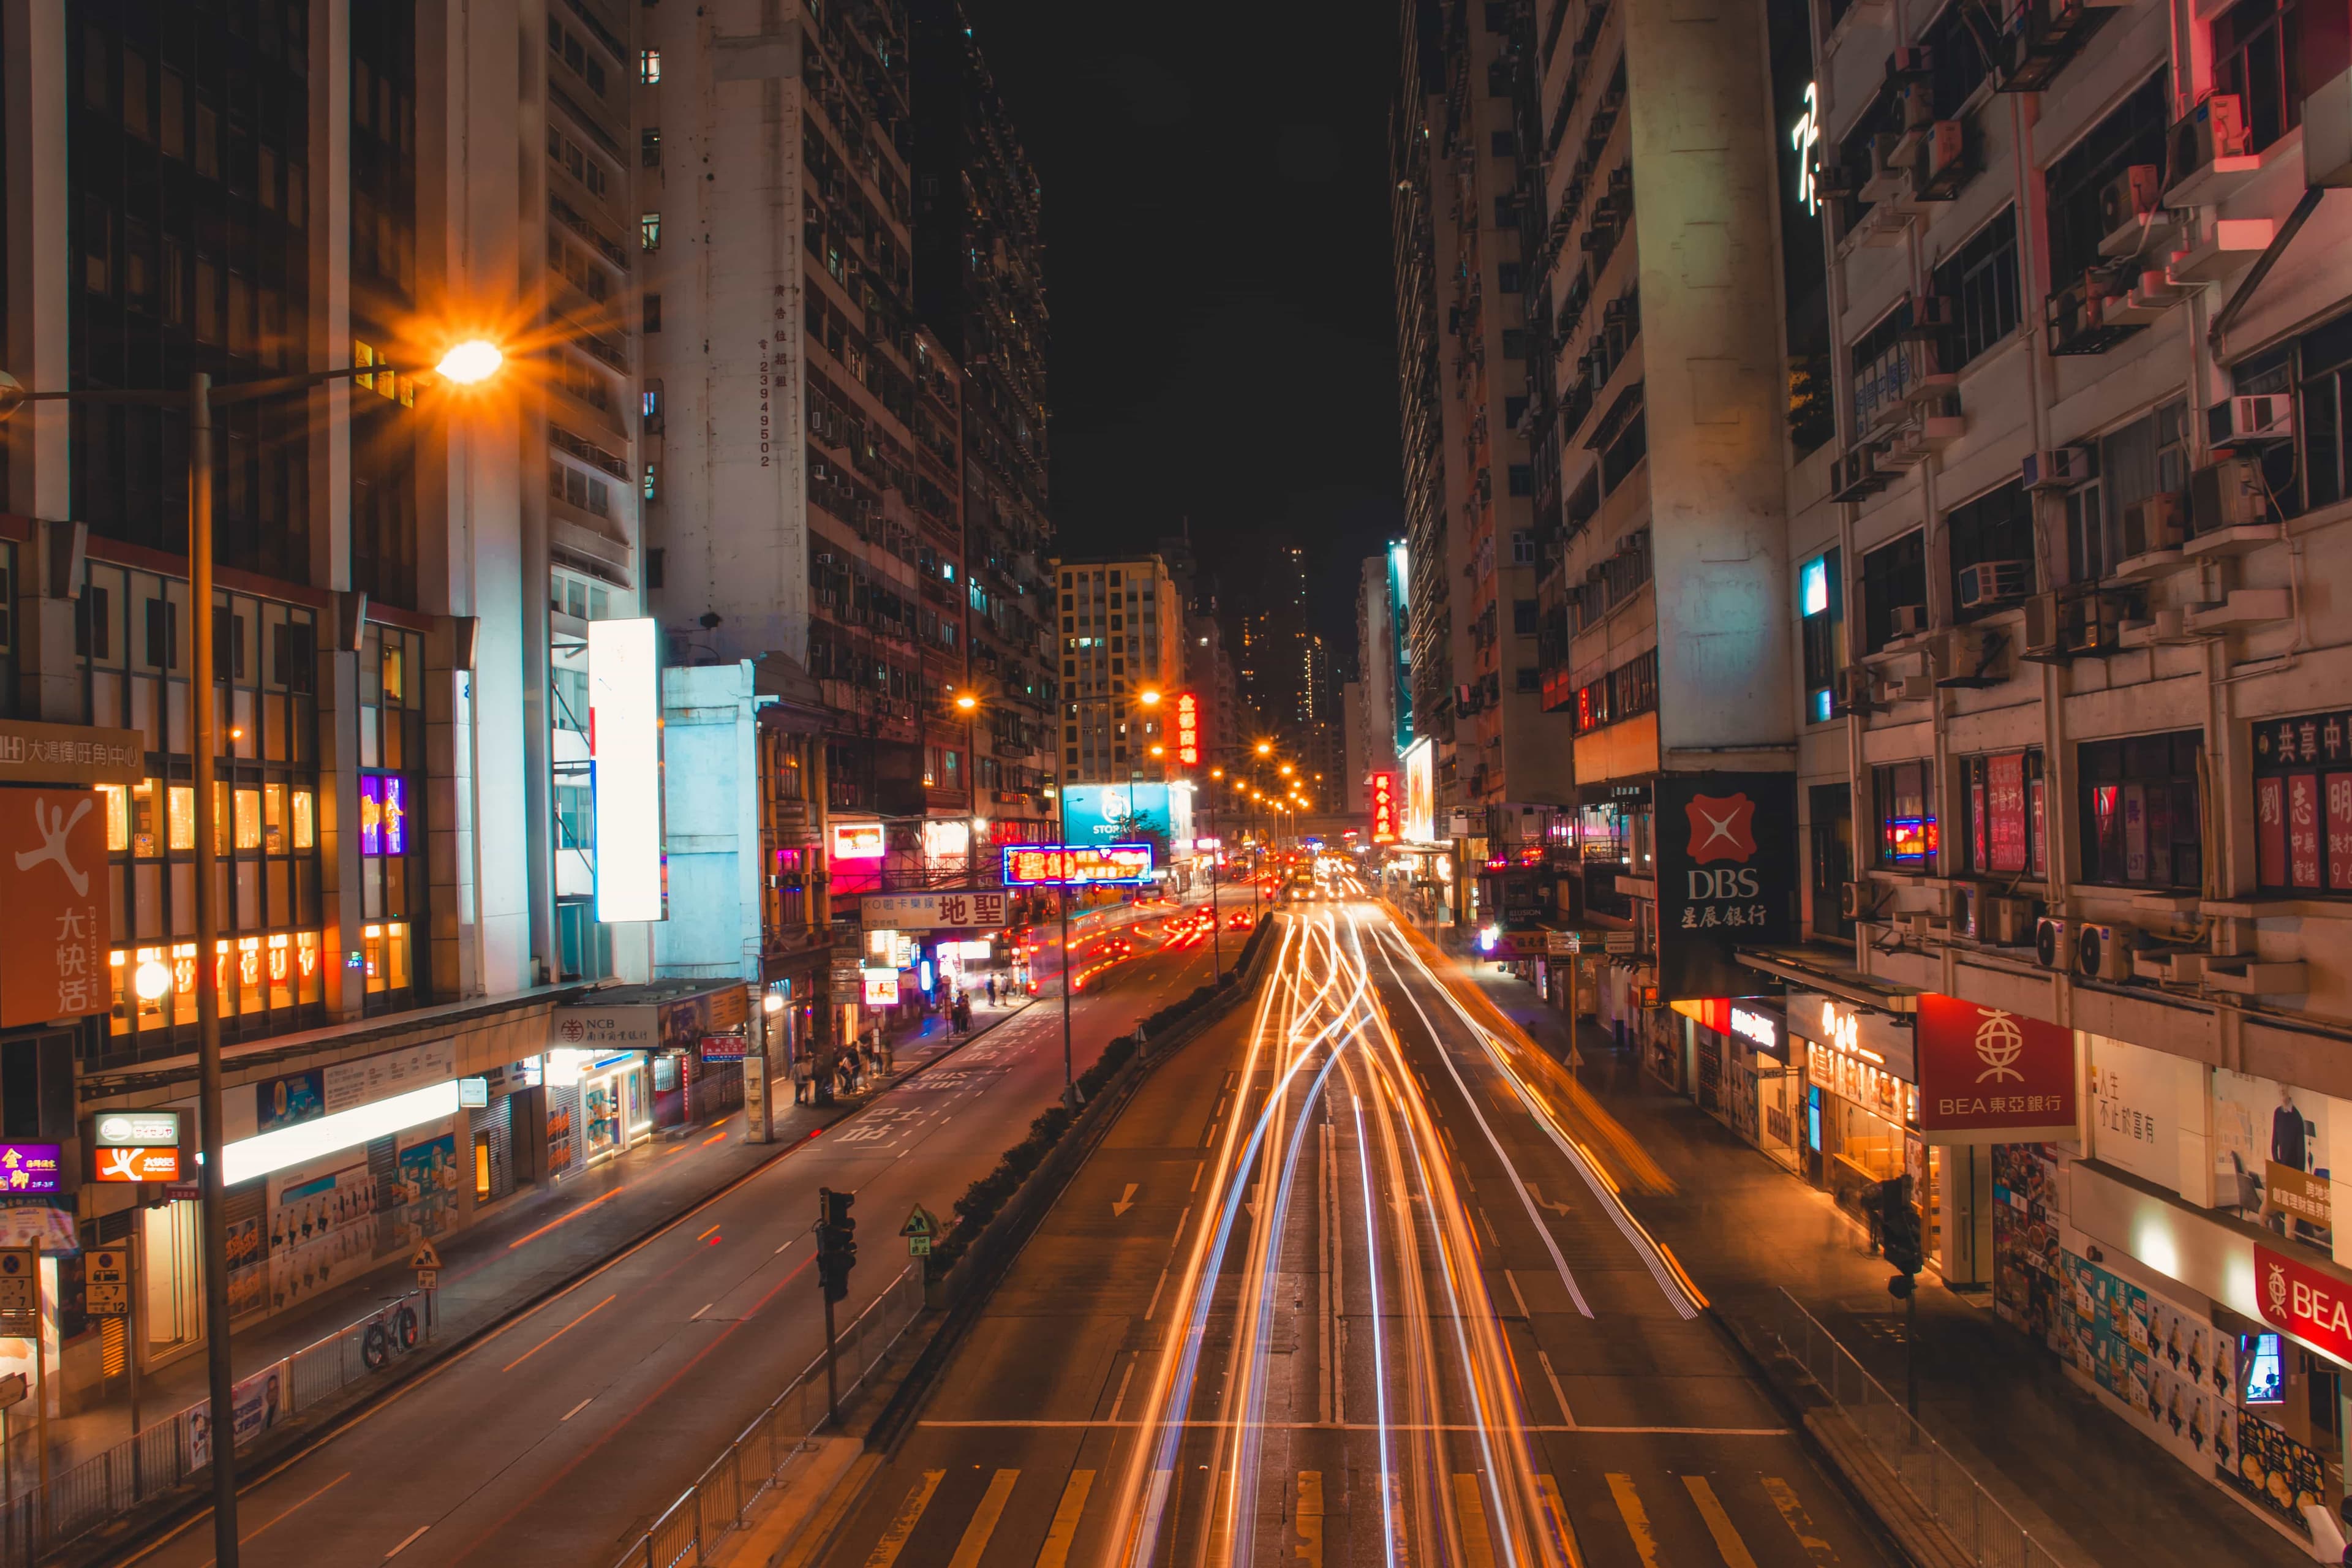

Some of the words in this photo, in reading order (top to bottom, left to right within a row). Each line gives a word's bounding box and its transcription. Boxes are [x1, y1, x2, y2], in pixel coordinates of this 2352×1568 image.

[2278, 717, 2352, 763] 共享中
[29, 739, 138, 767] 大鴻輝(旺角)中心
[2293, 859, 2316, 882] 電話
[1687, 868, 1760, 900] DBS
[1509, 908, 1542, 917] ILLUSION
[1681, 904, 1768, 929] 星展銀行
[55, 907, 88, 1014] 大快活
[586, 1019, 615, 1029] NCB
[899, 1080, 965, 1090] STOP
[919, 1071, 972, 1081] BUS
[2099, 1068, 2119, 1101] 人生
[855, 1106, 924, 1123] 巴士
[1939, 1098, 1987, 1115] BEA
[1989, 1095, 2062, 1114] 東亞銀行
[2100, 1099, 2154, 1144] 不止於富有
[832, 1123, 895, 1142] 站
[18, 1280, 24, 1290] 7
[111, 1287, 119, 1296] 7
[19, 1296, 26, 1306] 7
[113, 1302, 126, 1313] 12
[2293, 1280, 2352, 1341] BEA
